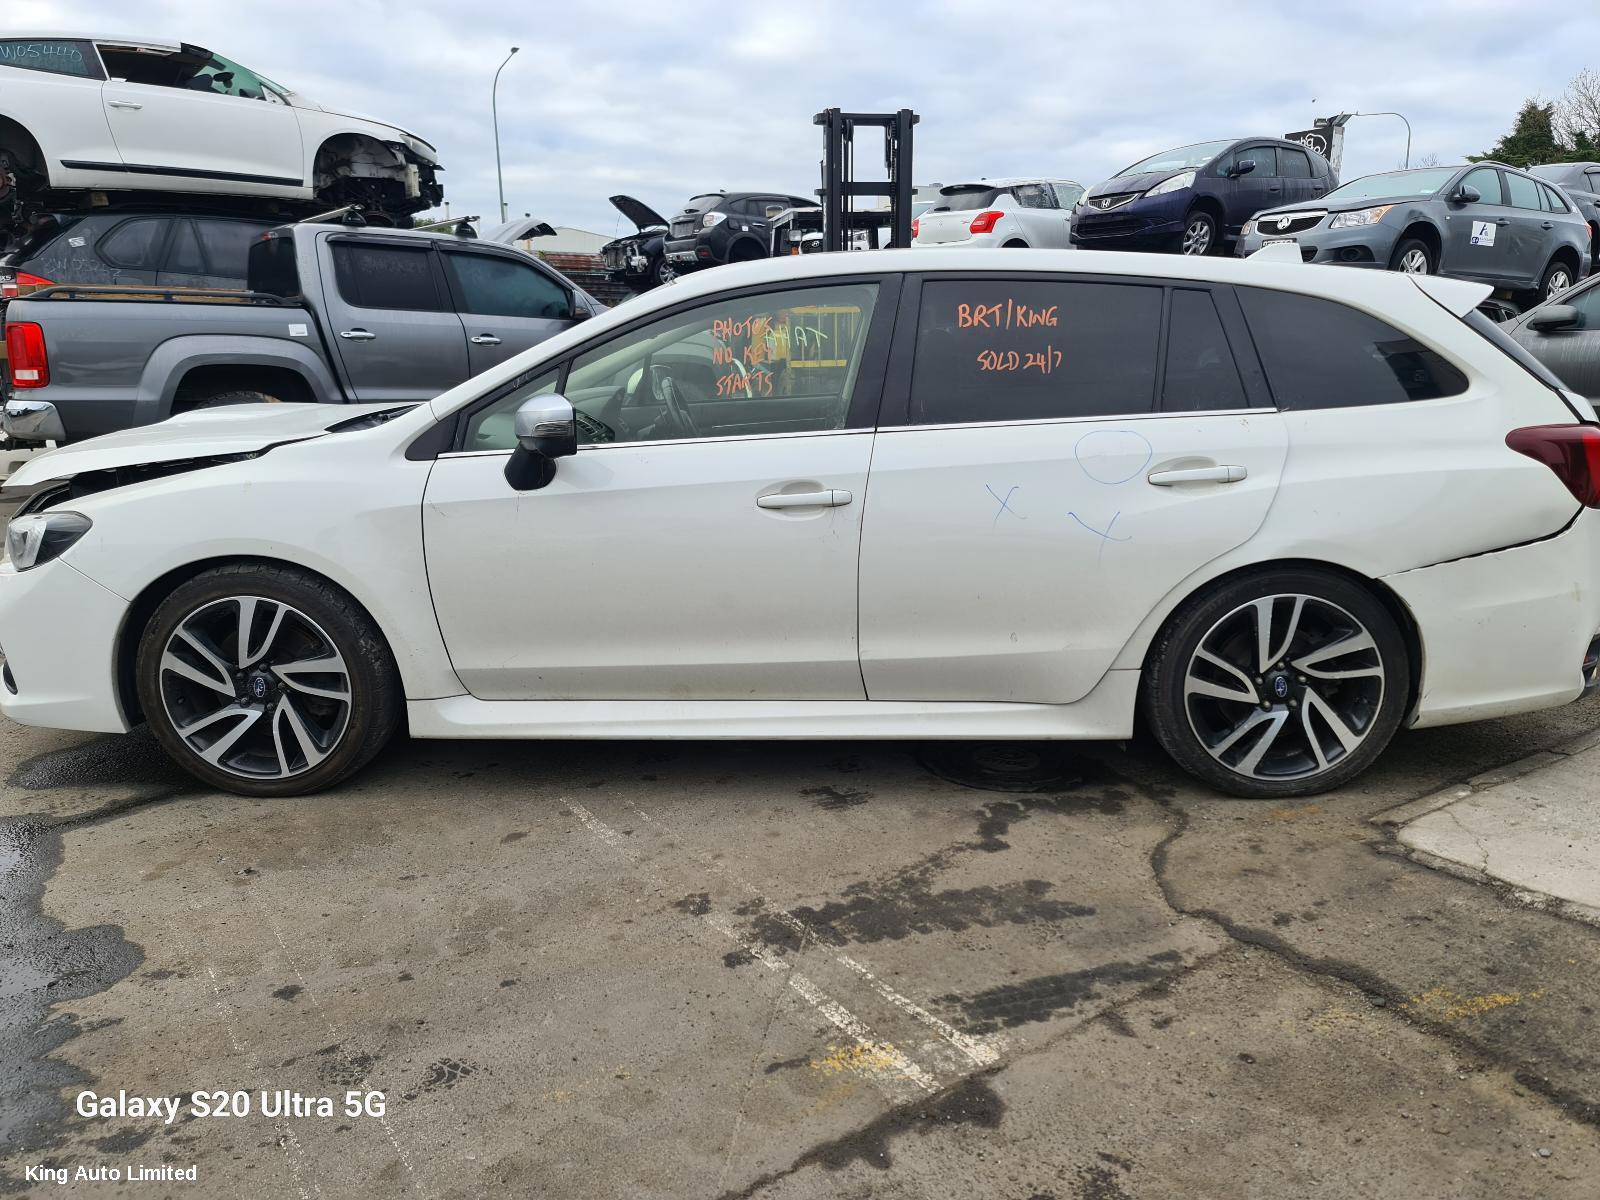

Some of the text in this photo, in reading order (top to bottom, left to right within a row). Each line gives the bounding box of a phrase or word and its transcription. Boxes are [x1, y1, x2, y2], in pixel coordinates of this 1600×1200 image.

[958, 298, 1058, 330] BRT/KING
[713, 316, 773, 342] PHOTOS
[712, 343, 773, 366] NO KEY
[976, 345, 1063, 375] SOLD 24/7
[716, 370, 774, 396] STARTS
